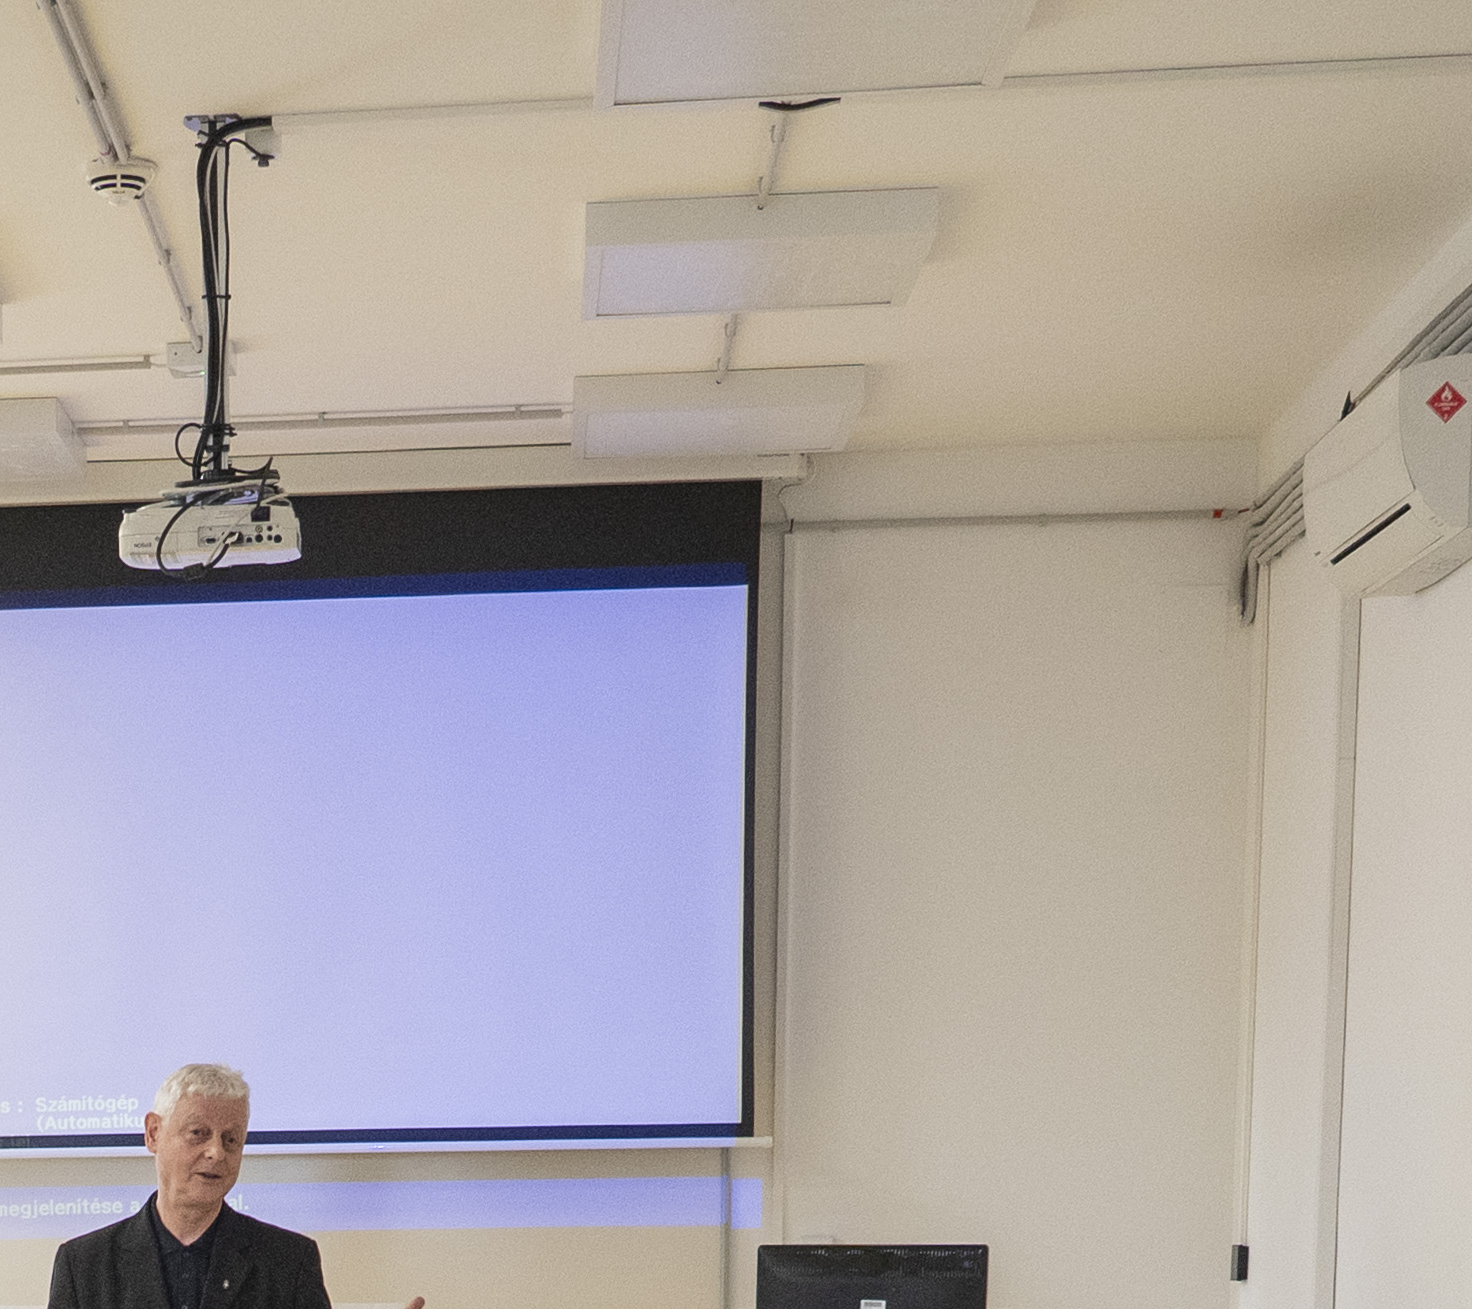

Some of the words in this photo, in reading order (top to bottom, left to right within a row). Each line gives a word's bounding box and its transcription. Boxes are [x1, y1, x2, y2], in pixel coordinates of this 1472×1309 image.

[35, 1094, 139, 1114] Számítógép
[36, 1114, 145, 1132] (Automatiku
[130, 1201, 141, 1213] a
